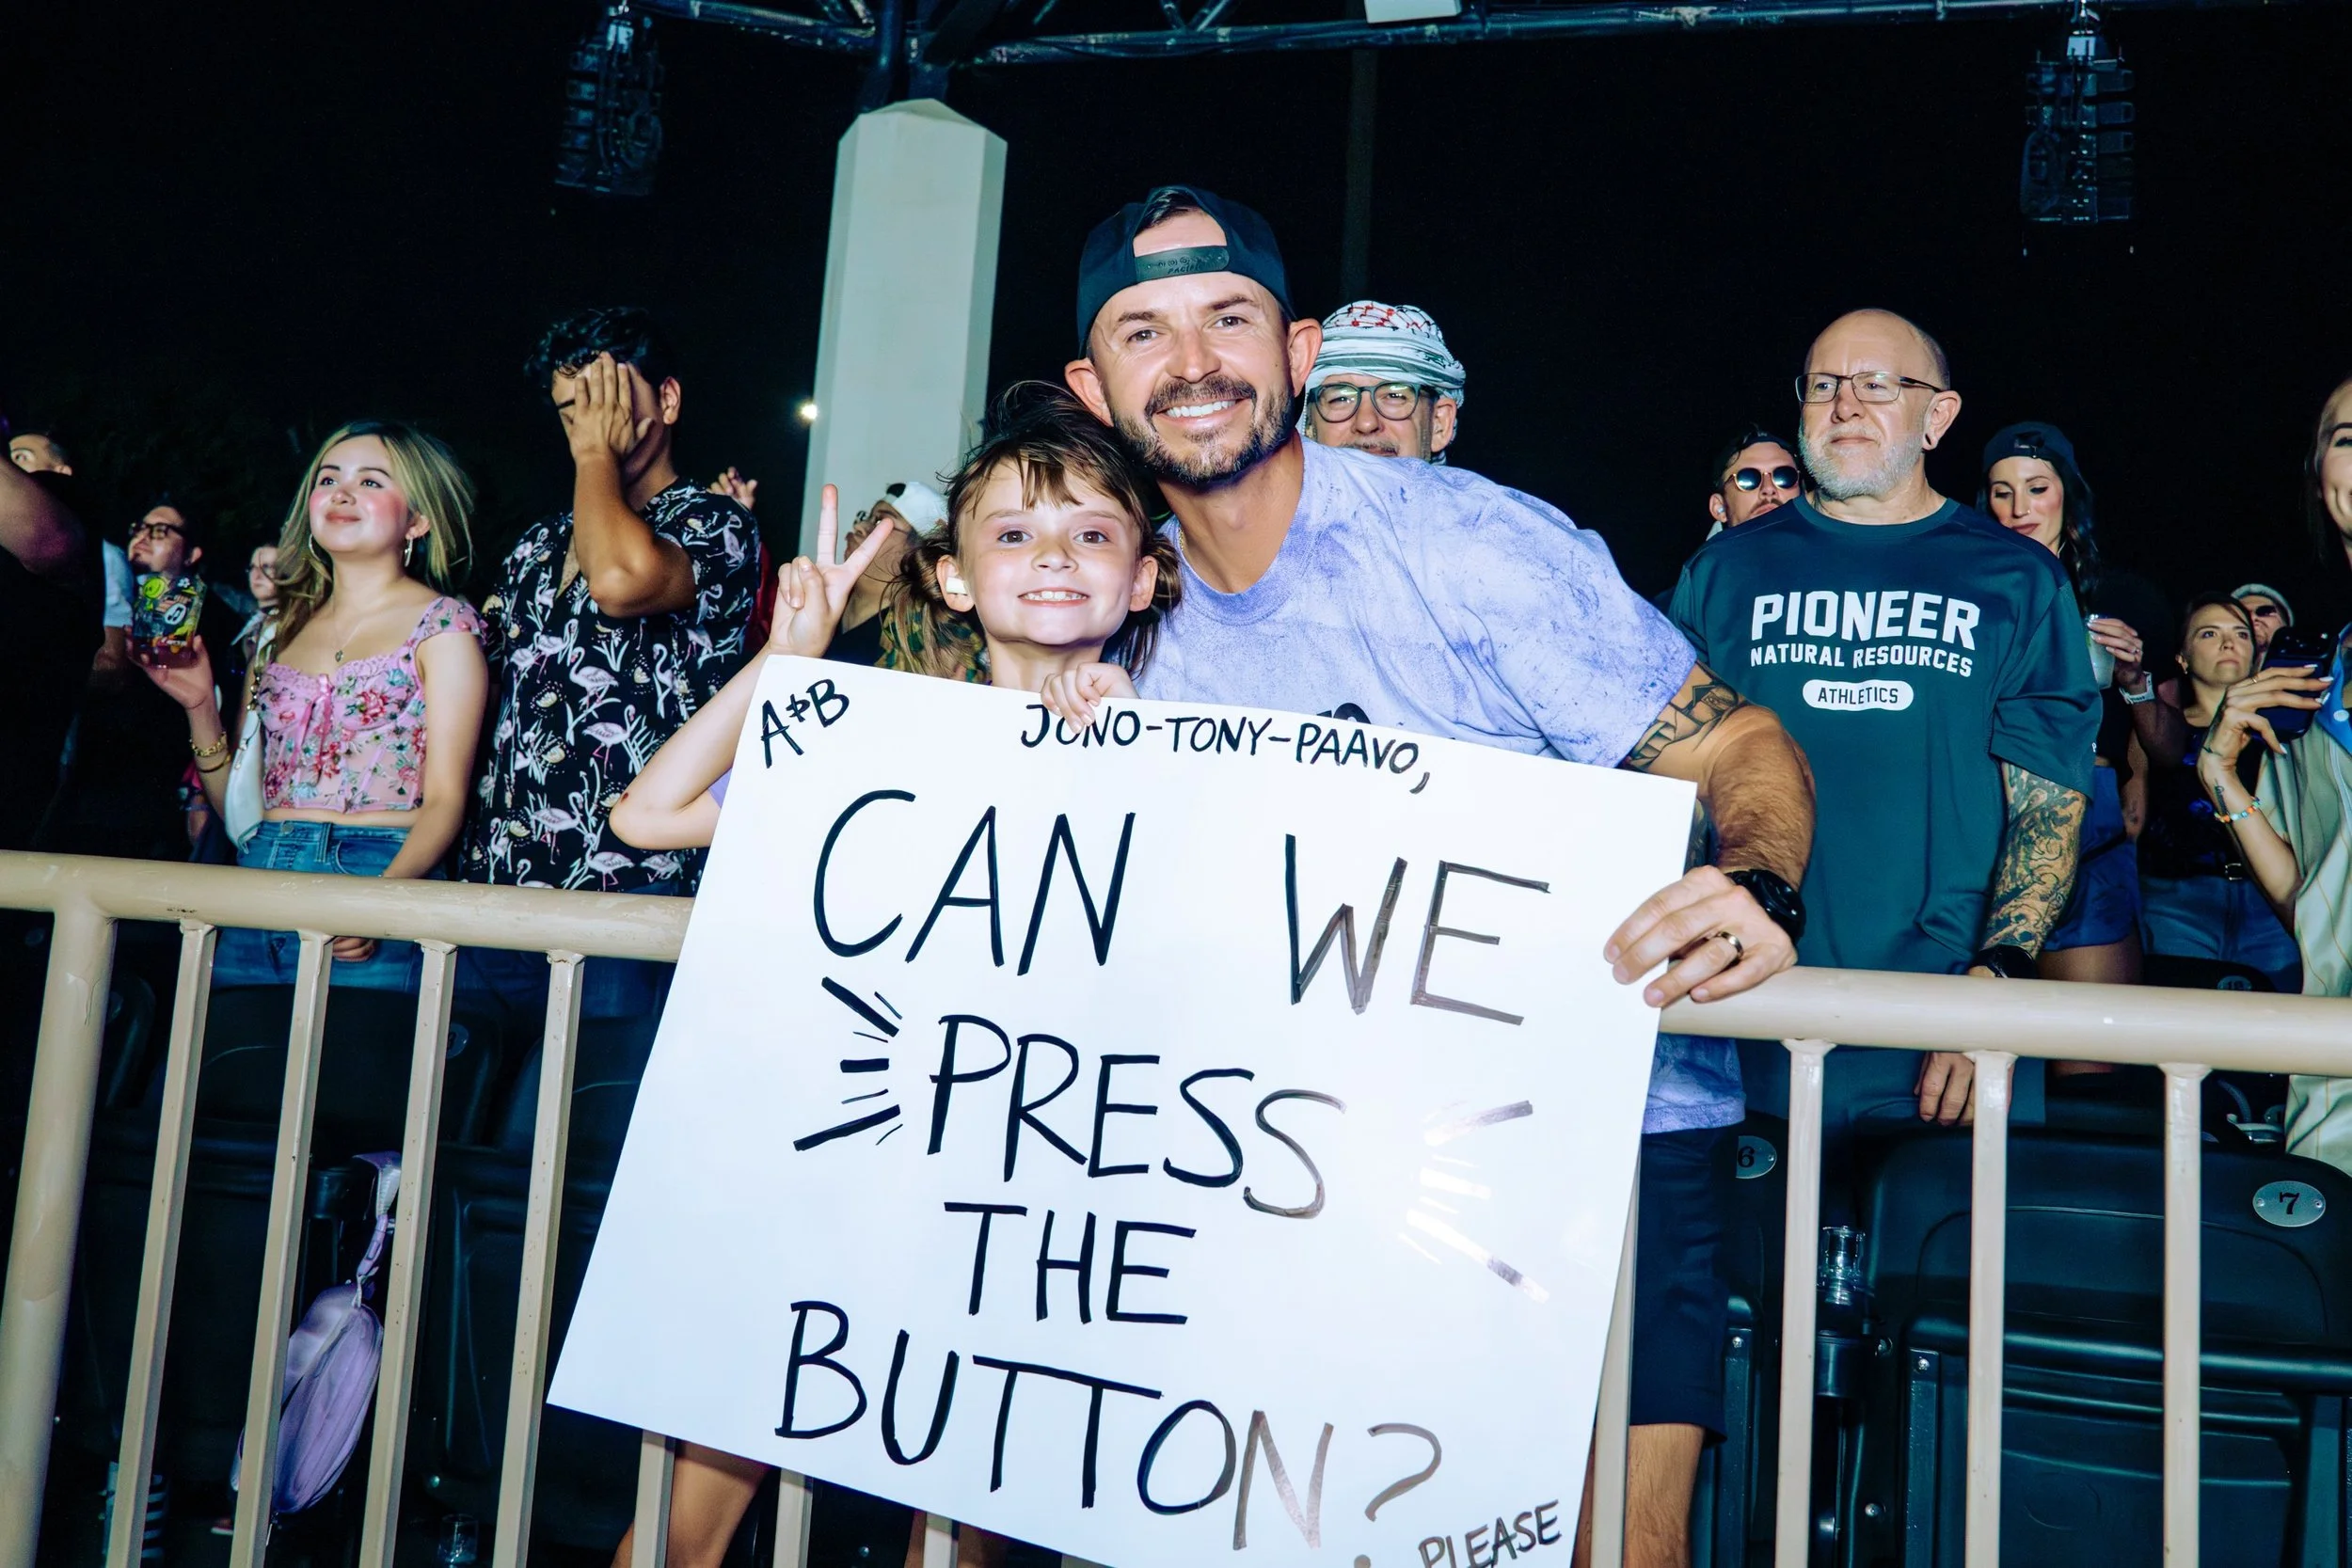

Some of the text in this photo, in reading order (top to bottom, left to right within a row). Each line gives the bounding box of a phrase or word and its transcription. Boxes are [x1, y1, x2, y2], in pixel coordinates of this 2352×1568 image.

[1752, 591, 1980, 650] PIONEER
[1751, 643, 1973, 677] NATURAL RESOURCES
[1818, 688, 1899, 705] ATHLETICS
[814, 789, 1550, 1025] CAN WE
[927, 1014, 1347, 1220] PRESS
[1738, 1146, 1755, 1168] 6
[2279, 1192, 2300, 1214] 7
[944, 1202, 1197, 1324] THE
[774, 1300, 1443, 1568] BUTTON?
[1418, 1499, 1563, 1568] PLEASE
